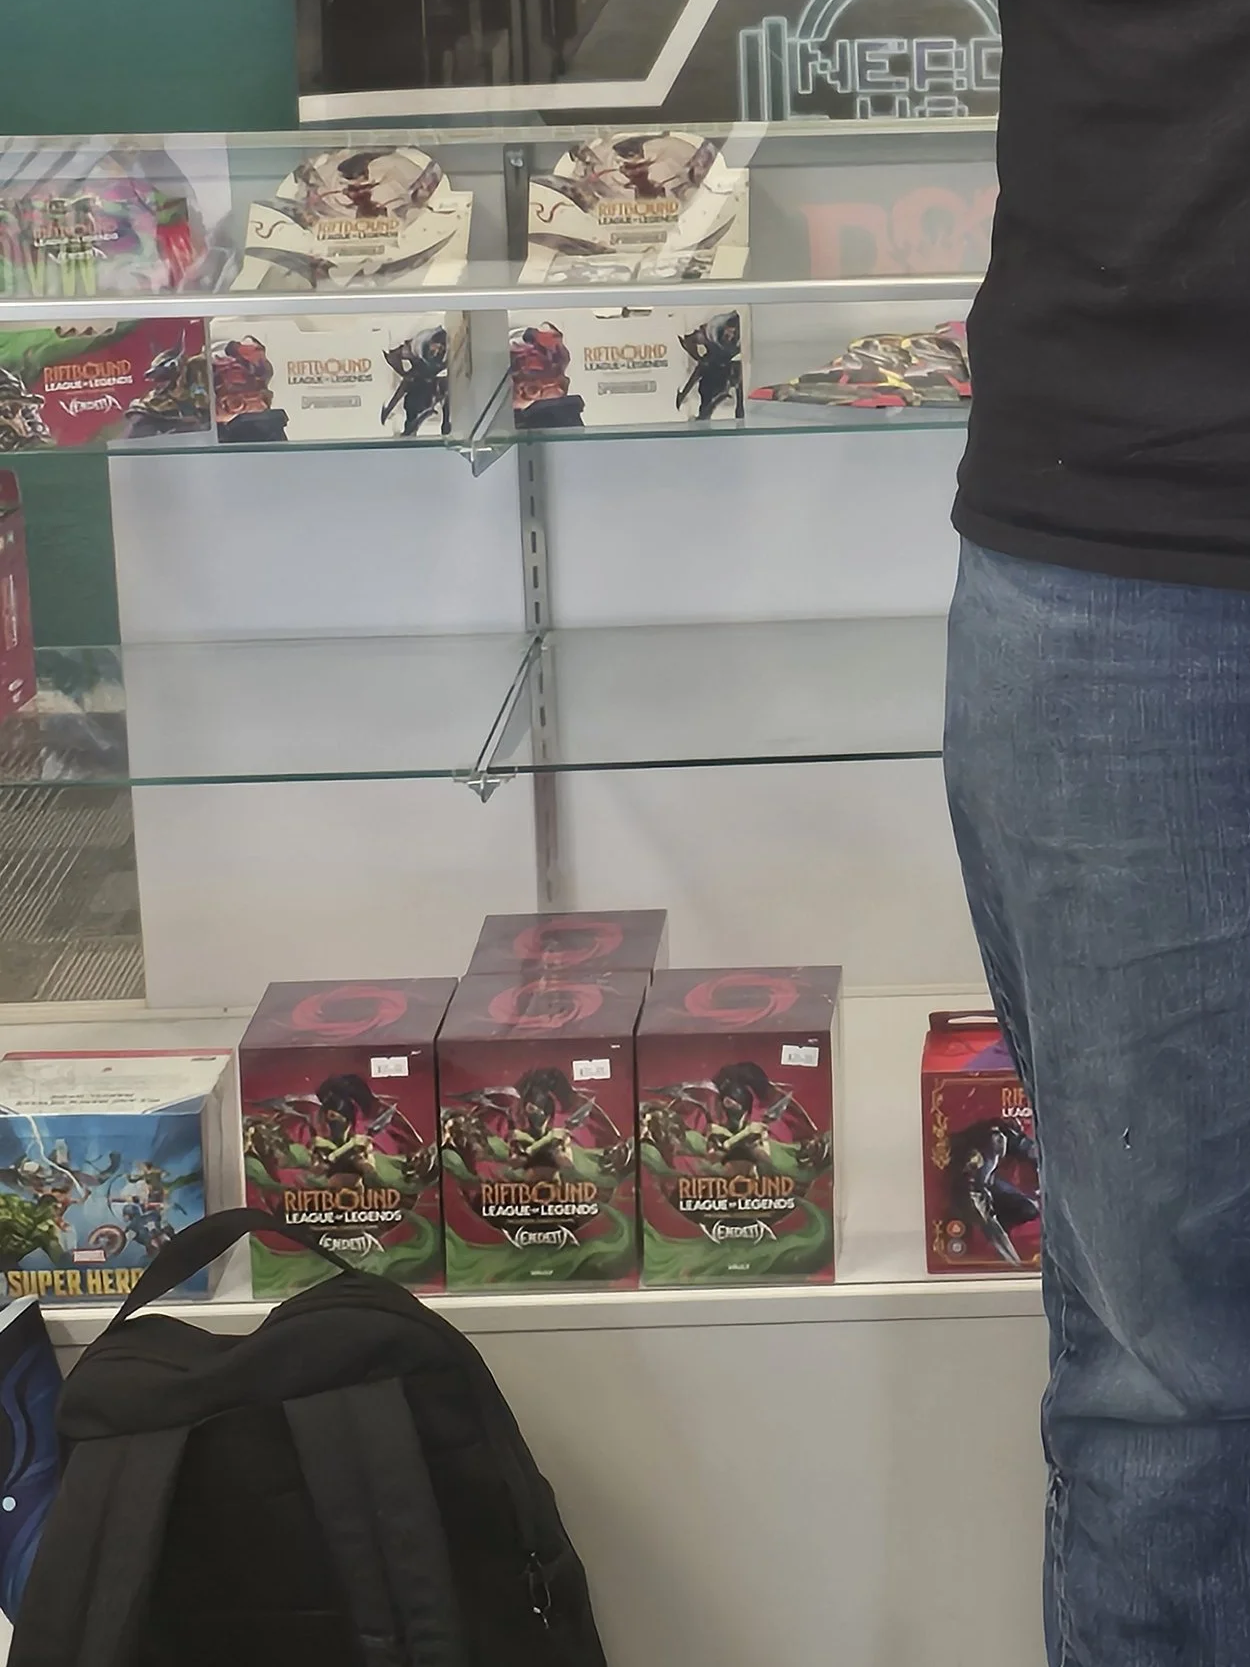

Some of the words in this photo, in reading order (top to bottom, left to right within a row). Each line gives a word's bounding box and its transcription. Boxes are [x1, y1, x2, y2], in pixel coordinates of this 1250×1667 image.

[584, 343, 668, 362] RIFTBOUND
[44, 360, 131, 383] RIFTBOUND
[287, 358, 372, 375] RIFTBOUND
[481, 1181, 597, 1205] RIFTBOUND
[679, 1175, 794, 1199] RIFTBOUND
[284, 1188, 400, 1211] RIFTBOUND
[482, 1205, 531, 1217] LEAGUE
[541, 1203, 598, 1216] LEGENDS
[680, 1199, 728, 1211] LEAGUE
[738, 1198, 795, 1210] LEGENDS
[285, 1211, 335, 1224] LEAGUE
[345, 1210, 401, 1223] LEGENDS
[502, 1225, 580, 1249] VENDETTA
[699, 1219, 777, 1245] VENDETTA
[7, 1269, 82, 1298] SUPER
